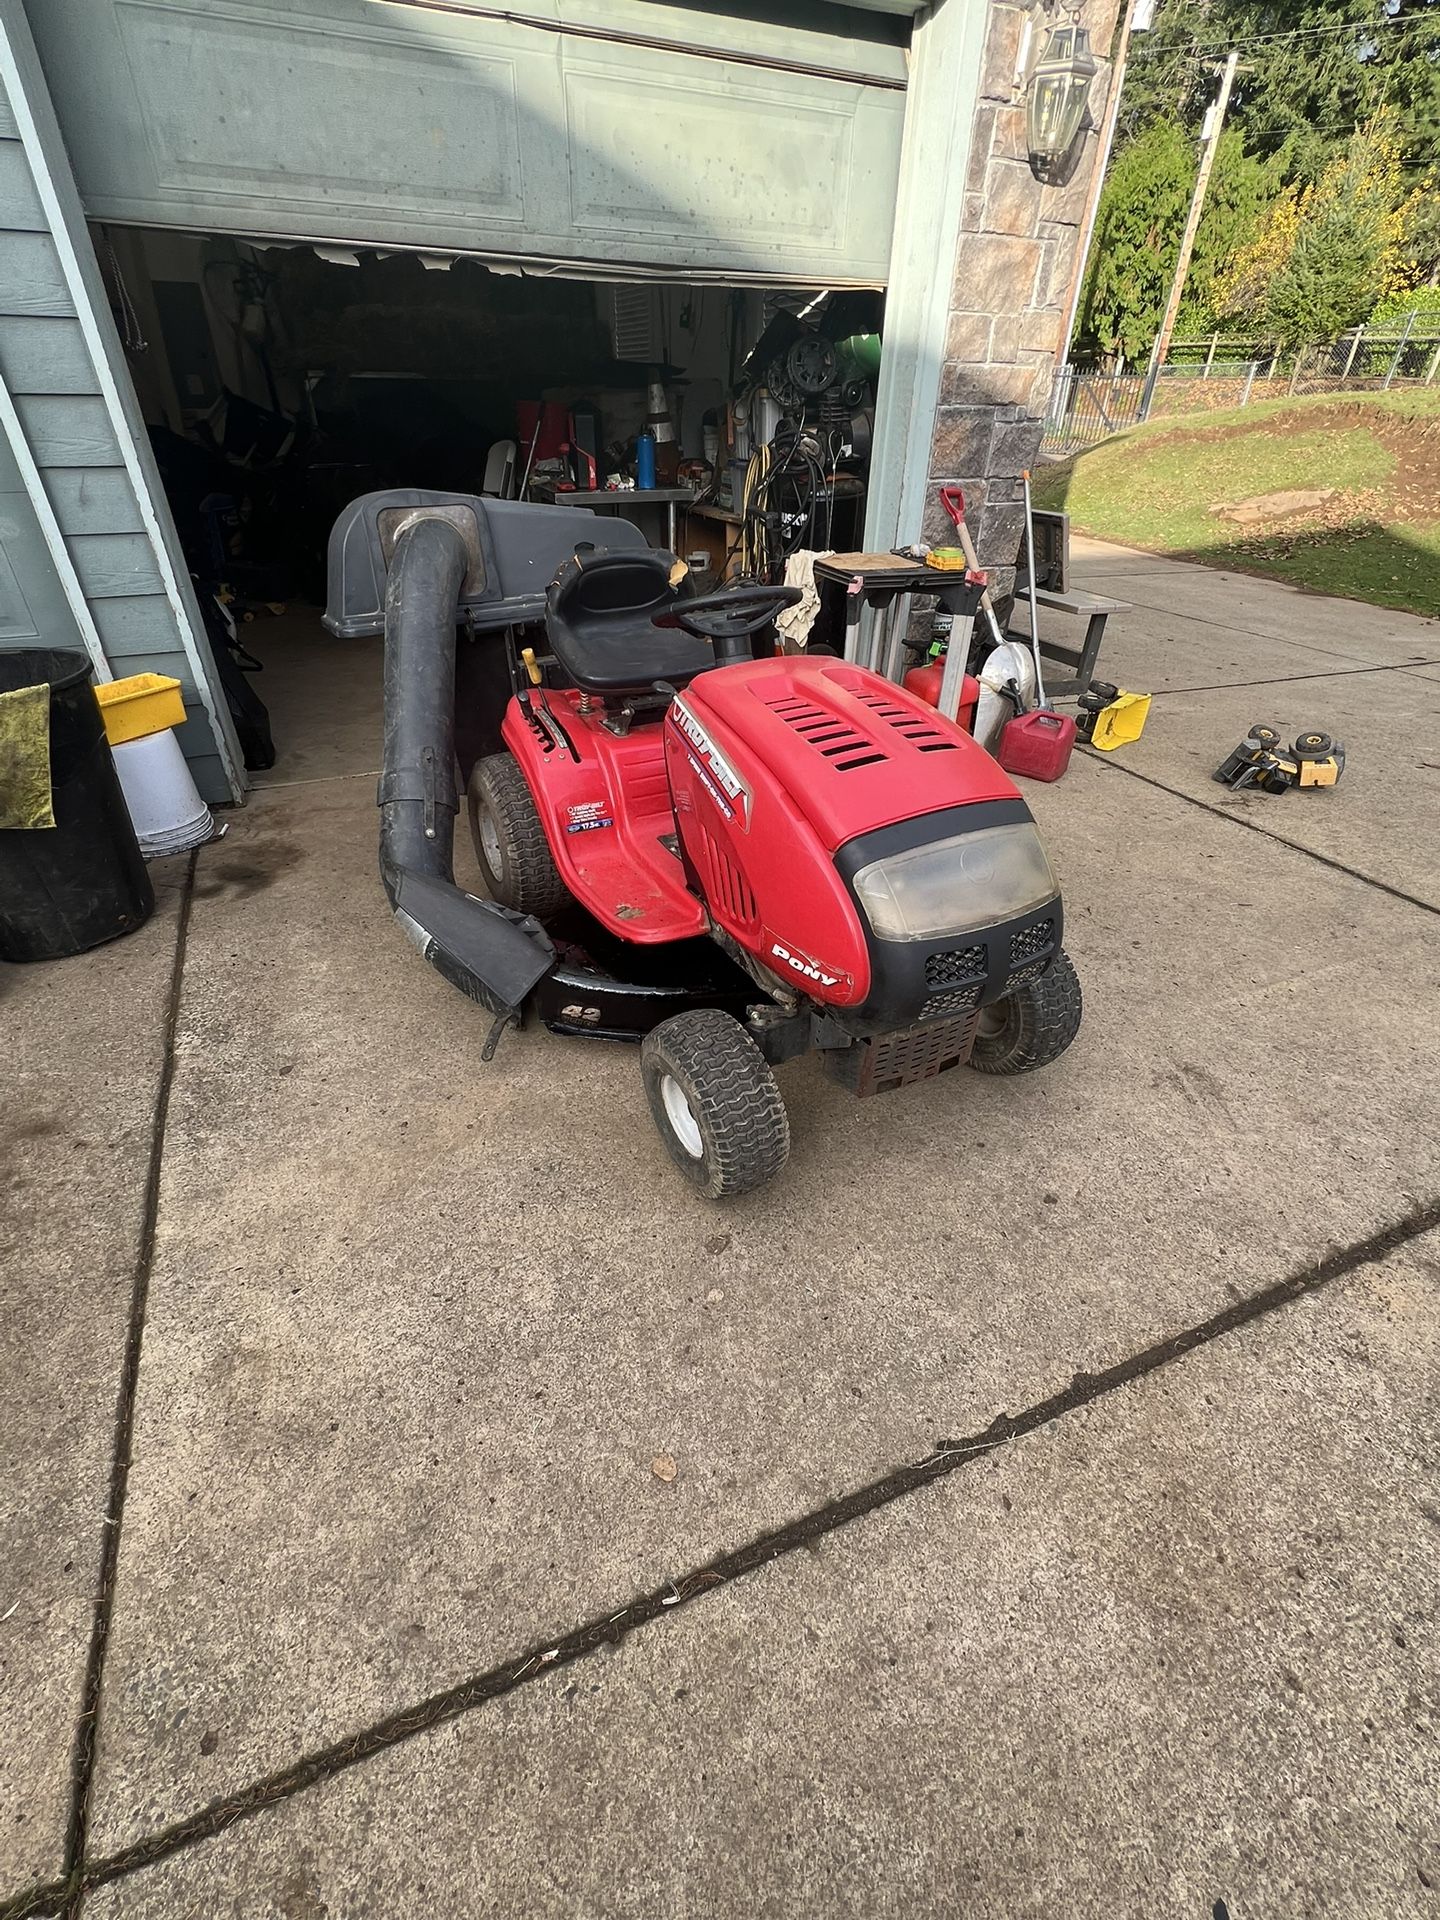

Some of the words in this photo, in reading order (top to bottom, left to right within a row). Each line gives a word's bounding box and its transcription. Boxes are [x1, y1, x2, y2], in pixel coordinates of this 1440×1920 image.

[781, 512, 808, 526] USKY
[771, 943, 838, 986] PONY
[561, 1004, 601, 1022] 42
